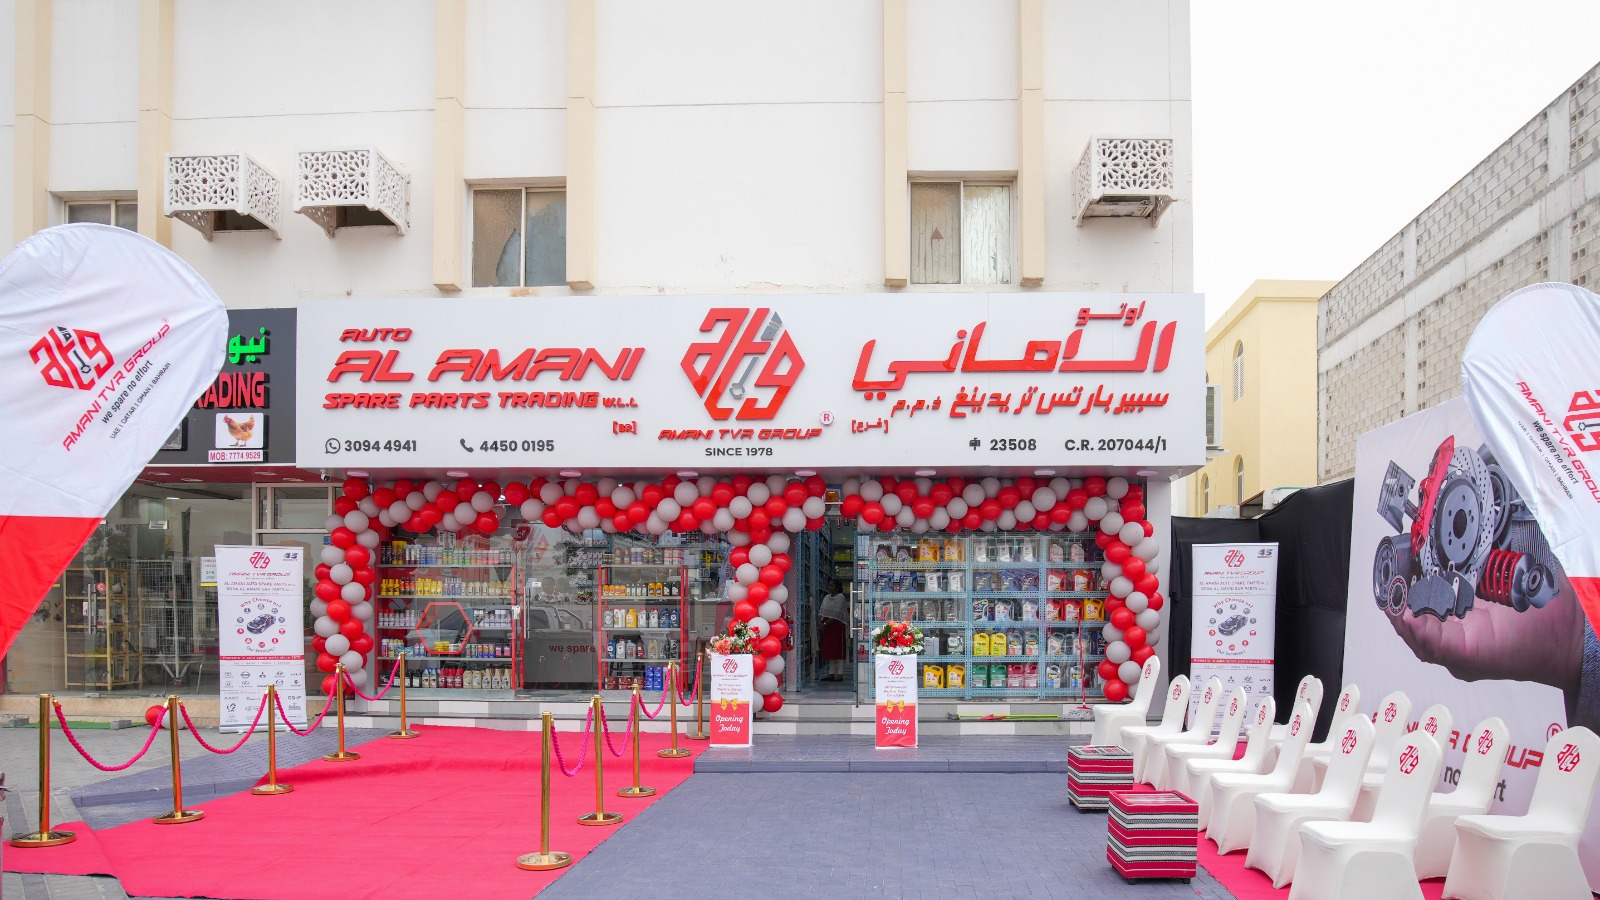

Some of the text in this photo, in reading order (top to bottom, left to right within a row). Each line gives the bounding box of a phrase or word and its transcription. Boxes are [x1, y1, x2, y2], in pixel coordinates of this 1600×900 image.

[339, 328, 412, 342] AUTO
[327, 348, 645, 382] AL AMANI
[63, 324, 170, 452] AMANI TVR GROUP
[102, 360, 153, 424] we spare no effort
[194, 371, 265, 407] ADING
[323, 392, 401, 408] SPARE
[409, 392, 491, 408] PARTS
[498, 391, 599, 408] TRADING
[1516, 382, 1553, 426] AMANI
[1552, 427, 1577, 457] TVR
[110, 427, 121, 439] UAE
[658, 428, 822, 440] AMANI TVR GROUP
[345, 440, 417, 452] 3094 4941
[480, 440, 555, 452] 4450 0195
[990, 439, 1037, 451] 23508
[1065, 437, 1168, 453] C.R. 207044/1
[210, 451, 261, 461] MOB: 7774 9529
[705, 447, 773, 456] SINCE 1978
[1533, 421, 1579, 484] we spare no effort
[549, 645, 596, 654] we spare
[716, 714, 744, 724] Opening
[881, 717, 910, 727] Opening
[718, 723, 741, 733] Today
[885, 726, 907, 735] Today
